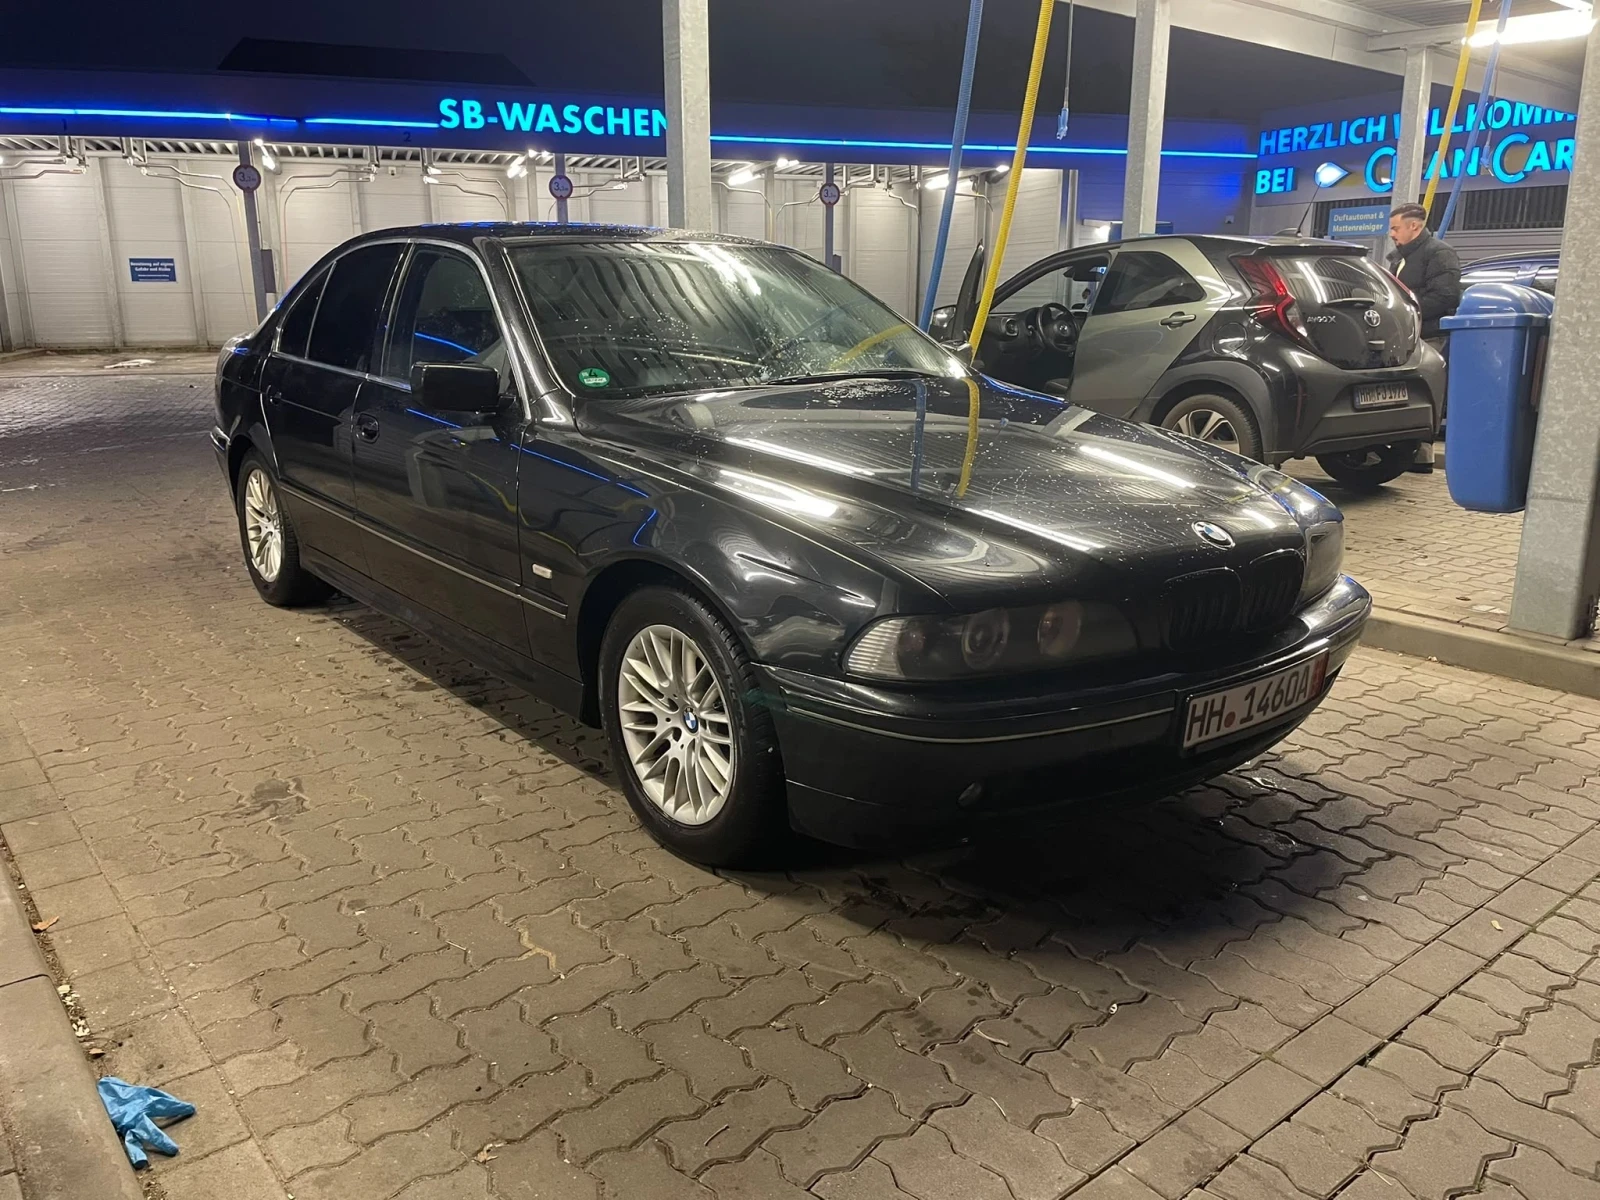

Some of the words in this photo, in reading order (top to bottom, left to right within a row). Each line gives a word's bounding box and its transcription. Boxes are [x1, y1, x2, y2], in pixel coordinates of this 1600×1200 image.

[1259, 114, 1387, 156] HERZLICH
[1255, 167, 1295, 195] BEI
[1332, 222, 1384, 232] Mattenreiniger
[1333, 212, 1377, 222] Duftautomat
[1378, 211, 1385, 219] &
[1187, 695, 1227, 741] HH
[1239, 665, 1310, 725] 1460A
